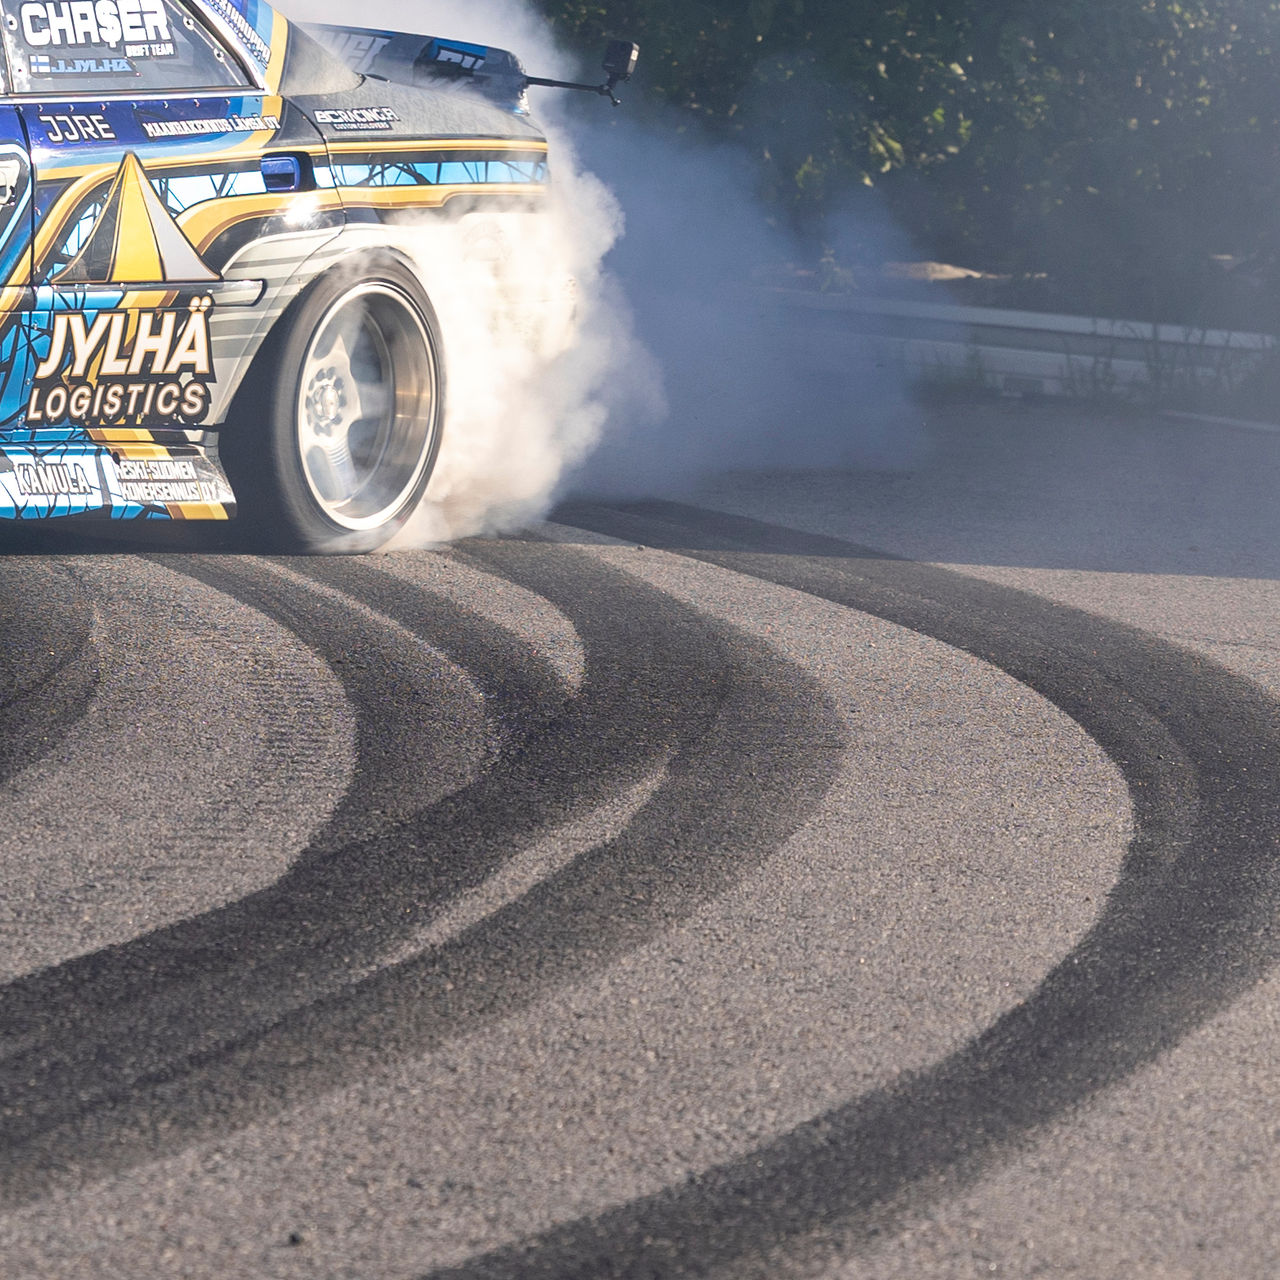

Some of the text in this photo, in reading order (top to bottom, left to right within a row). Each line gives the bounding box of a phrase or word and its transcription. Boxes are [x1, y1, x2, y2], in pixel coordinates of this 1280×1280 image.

[150, 43, 174, 56] TEAM
[40, 114, 116, 142] JJRE
[35, 296, 212, 379] JYLHÄ
[27, 382, 207, 421] LOGISTICS
[15, 463, 92, 495] KAMULA
